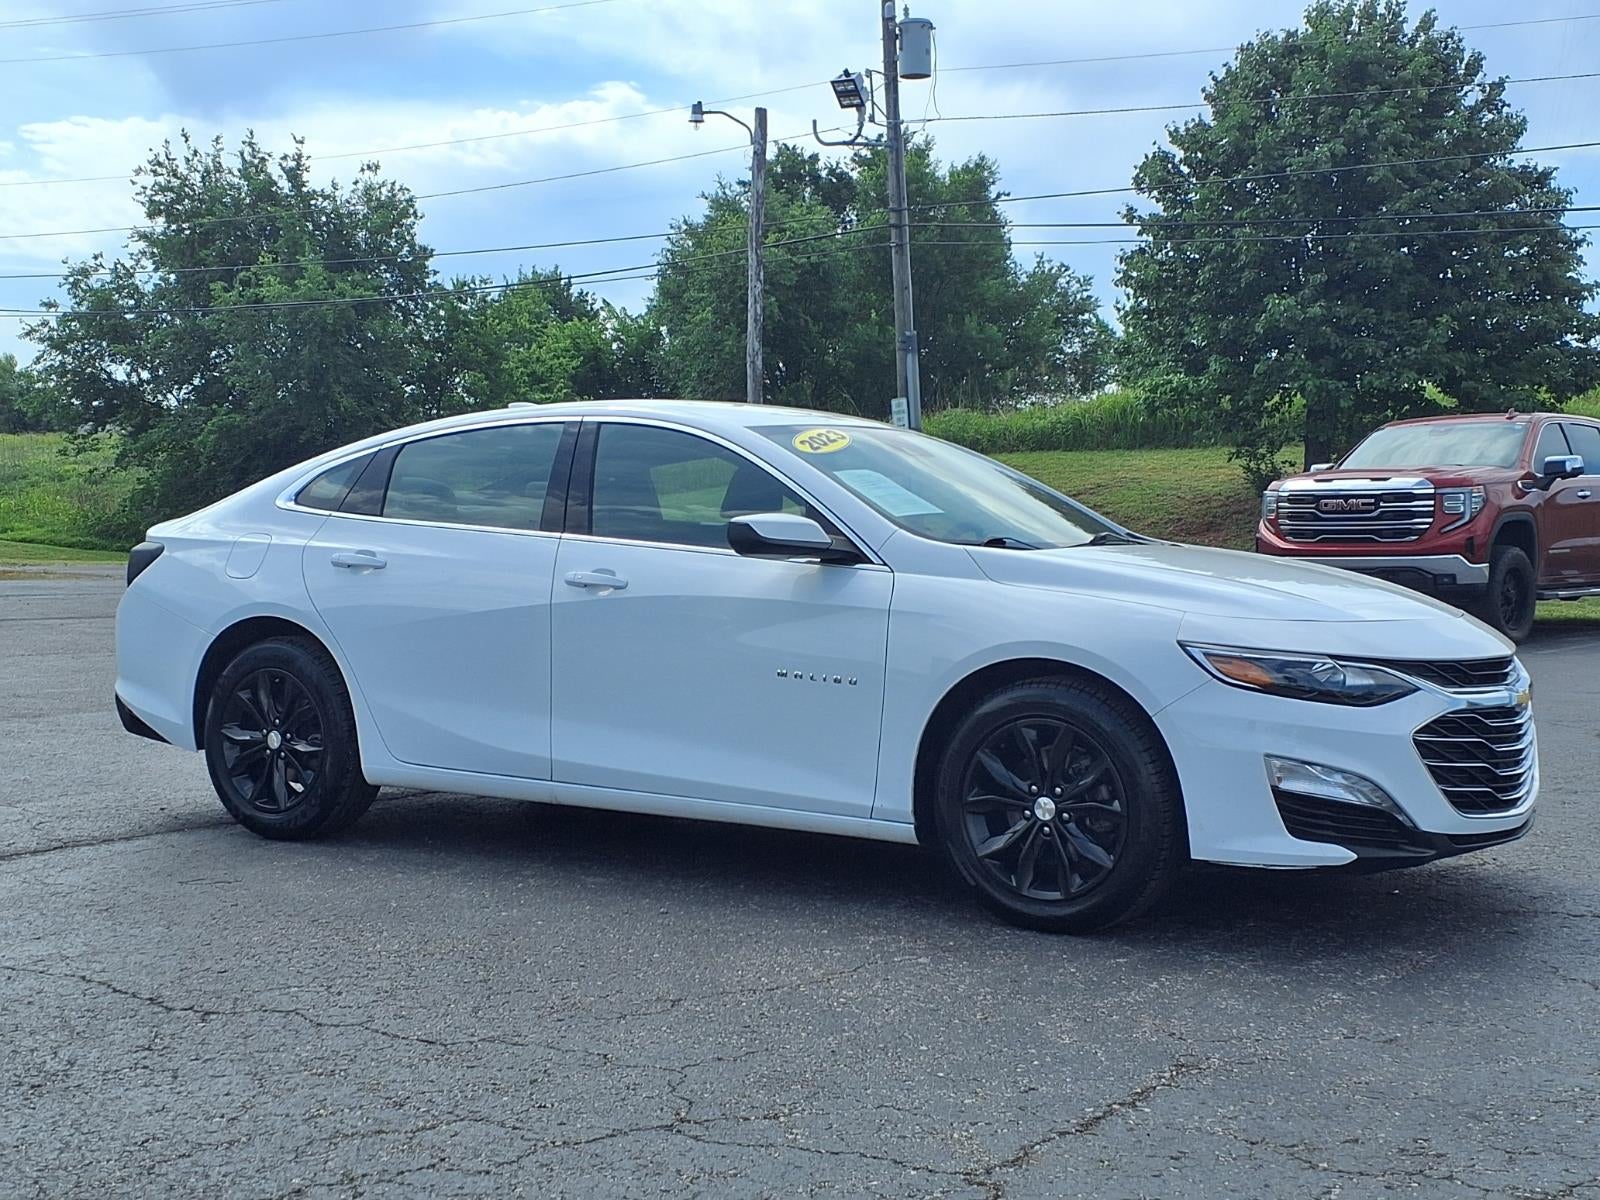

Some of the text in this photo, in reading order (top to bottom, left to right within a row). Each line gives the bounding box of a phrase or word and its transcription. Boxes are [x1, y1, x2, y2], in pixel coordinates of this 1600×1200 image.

[799, 430, 847, 451] 2023
[1320, 499, 1375, 510] GMC
[776, 668, 858, 686] MALIBU
